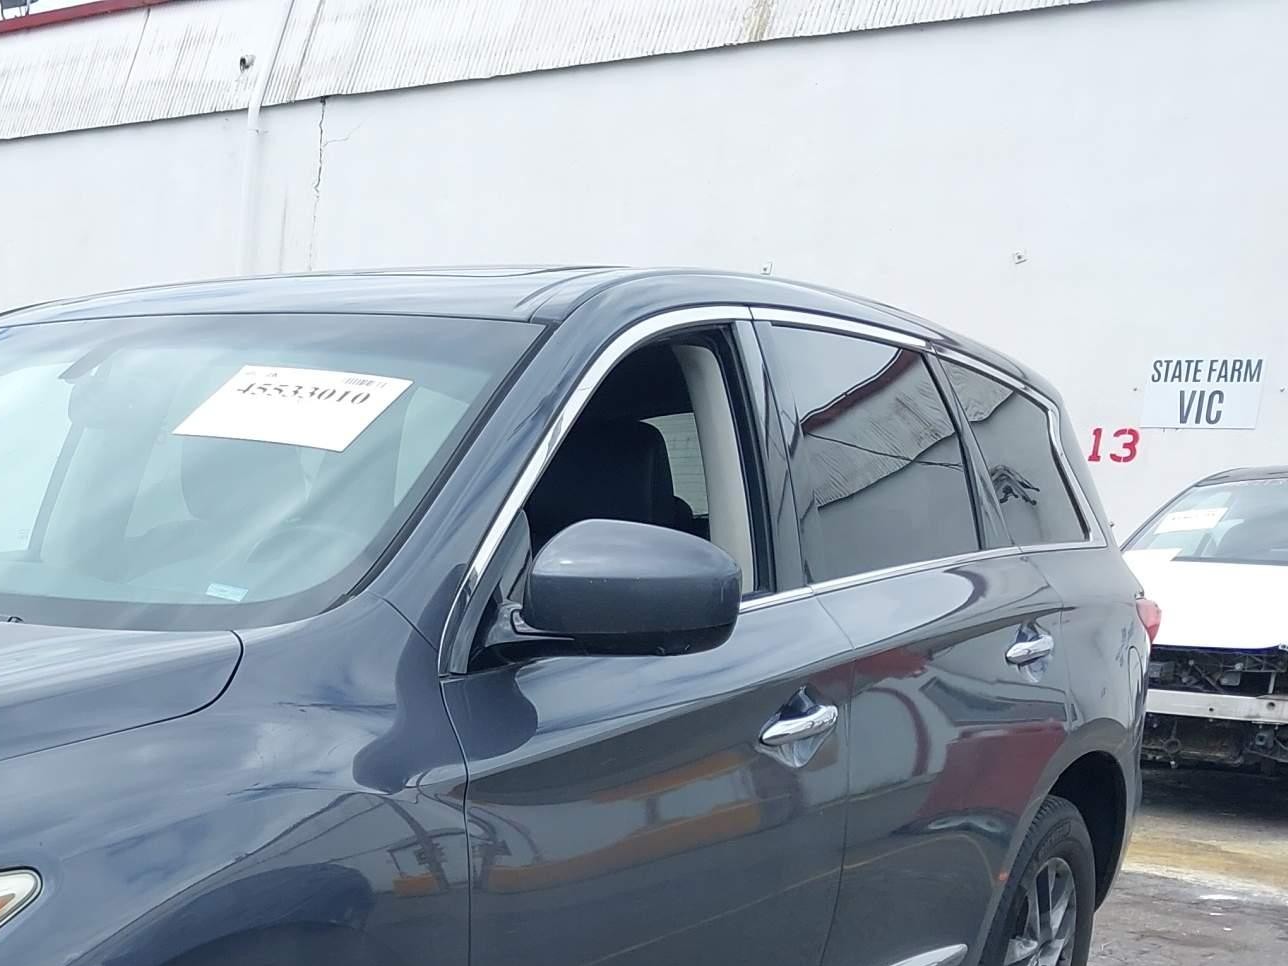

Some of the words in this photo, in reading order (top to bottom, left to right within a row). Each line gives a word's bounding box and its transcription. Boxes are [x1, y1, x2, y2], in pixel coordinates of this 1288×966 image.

[1151, 359, 1203, 383] STATE
[1206, 359, 1263, 383] FARM
[237, 382, 371, 405] 45533010
[1179, 389, 1225, 425] VIC
[1087, 427, 1141, 463] 13
